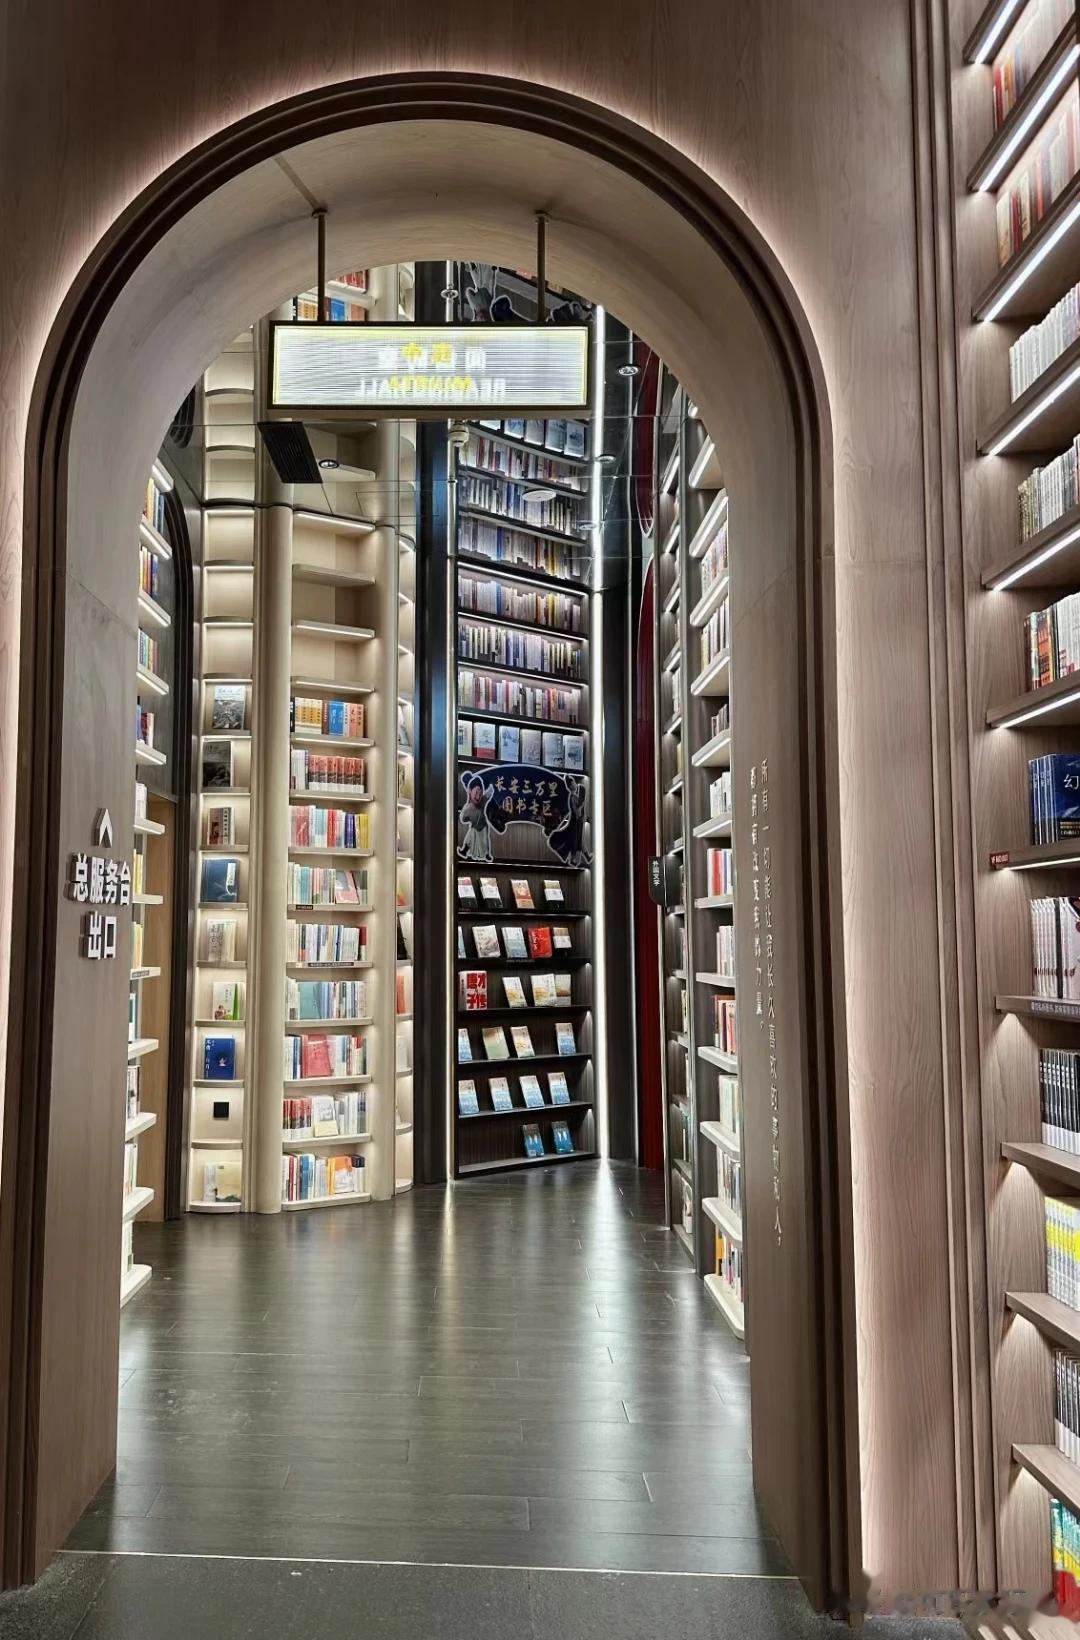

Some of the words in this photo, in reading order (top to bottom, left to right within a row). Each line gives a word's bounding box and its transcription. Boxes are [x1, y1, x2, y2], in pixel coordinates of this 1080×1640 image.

[494, 776, 559, 797] 长安三万里
[501, 796, 553, 816] 图书专区
[71, 853, 131, 906] 总服务台
[86, 911, 117, 960] 出口
